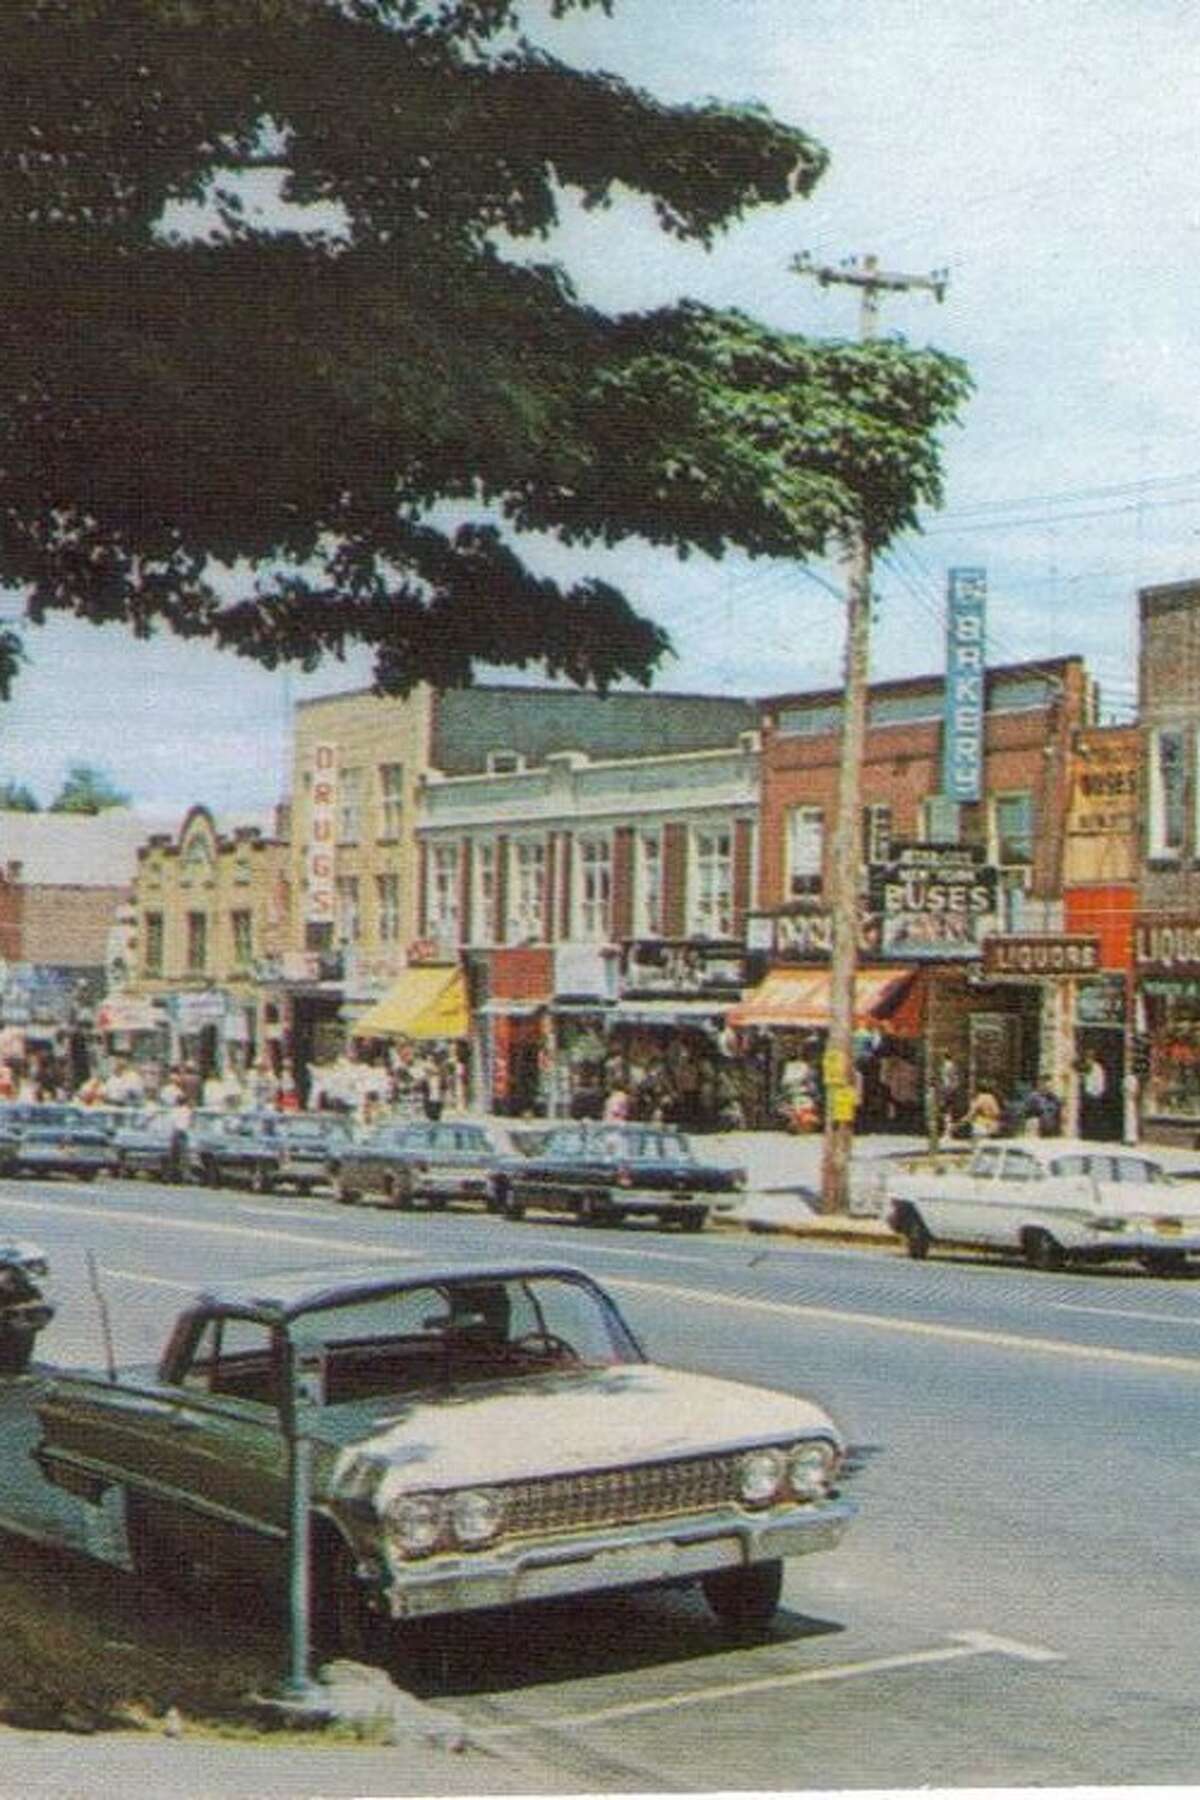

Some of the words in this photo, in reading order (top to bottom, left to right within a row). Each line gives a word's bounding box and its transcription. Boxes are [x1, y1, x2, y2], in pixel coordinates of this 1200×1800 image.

[313, 746, 335, 911] DRUGS
[884, 881, 990, 912] BUSES
[997, 945, 1094, 971] LIQUORS
